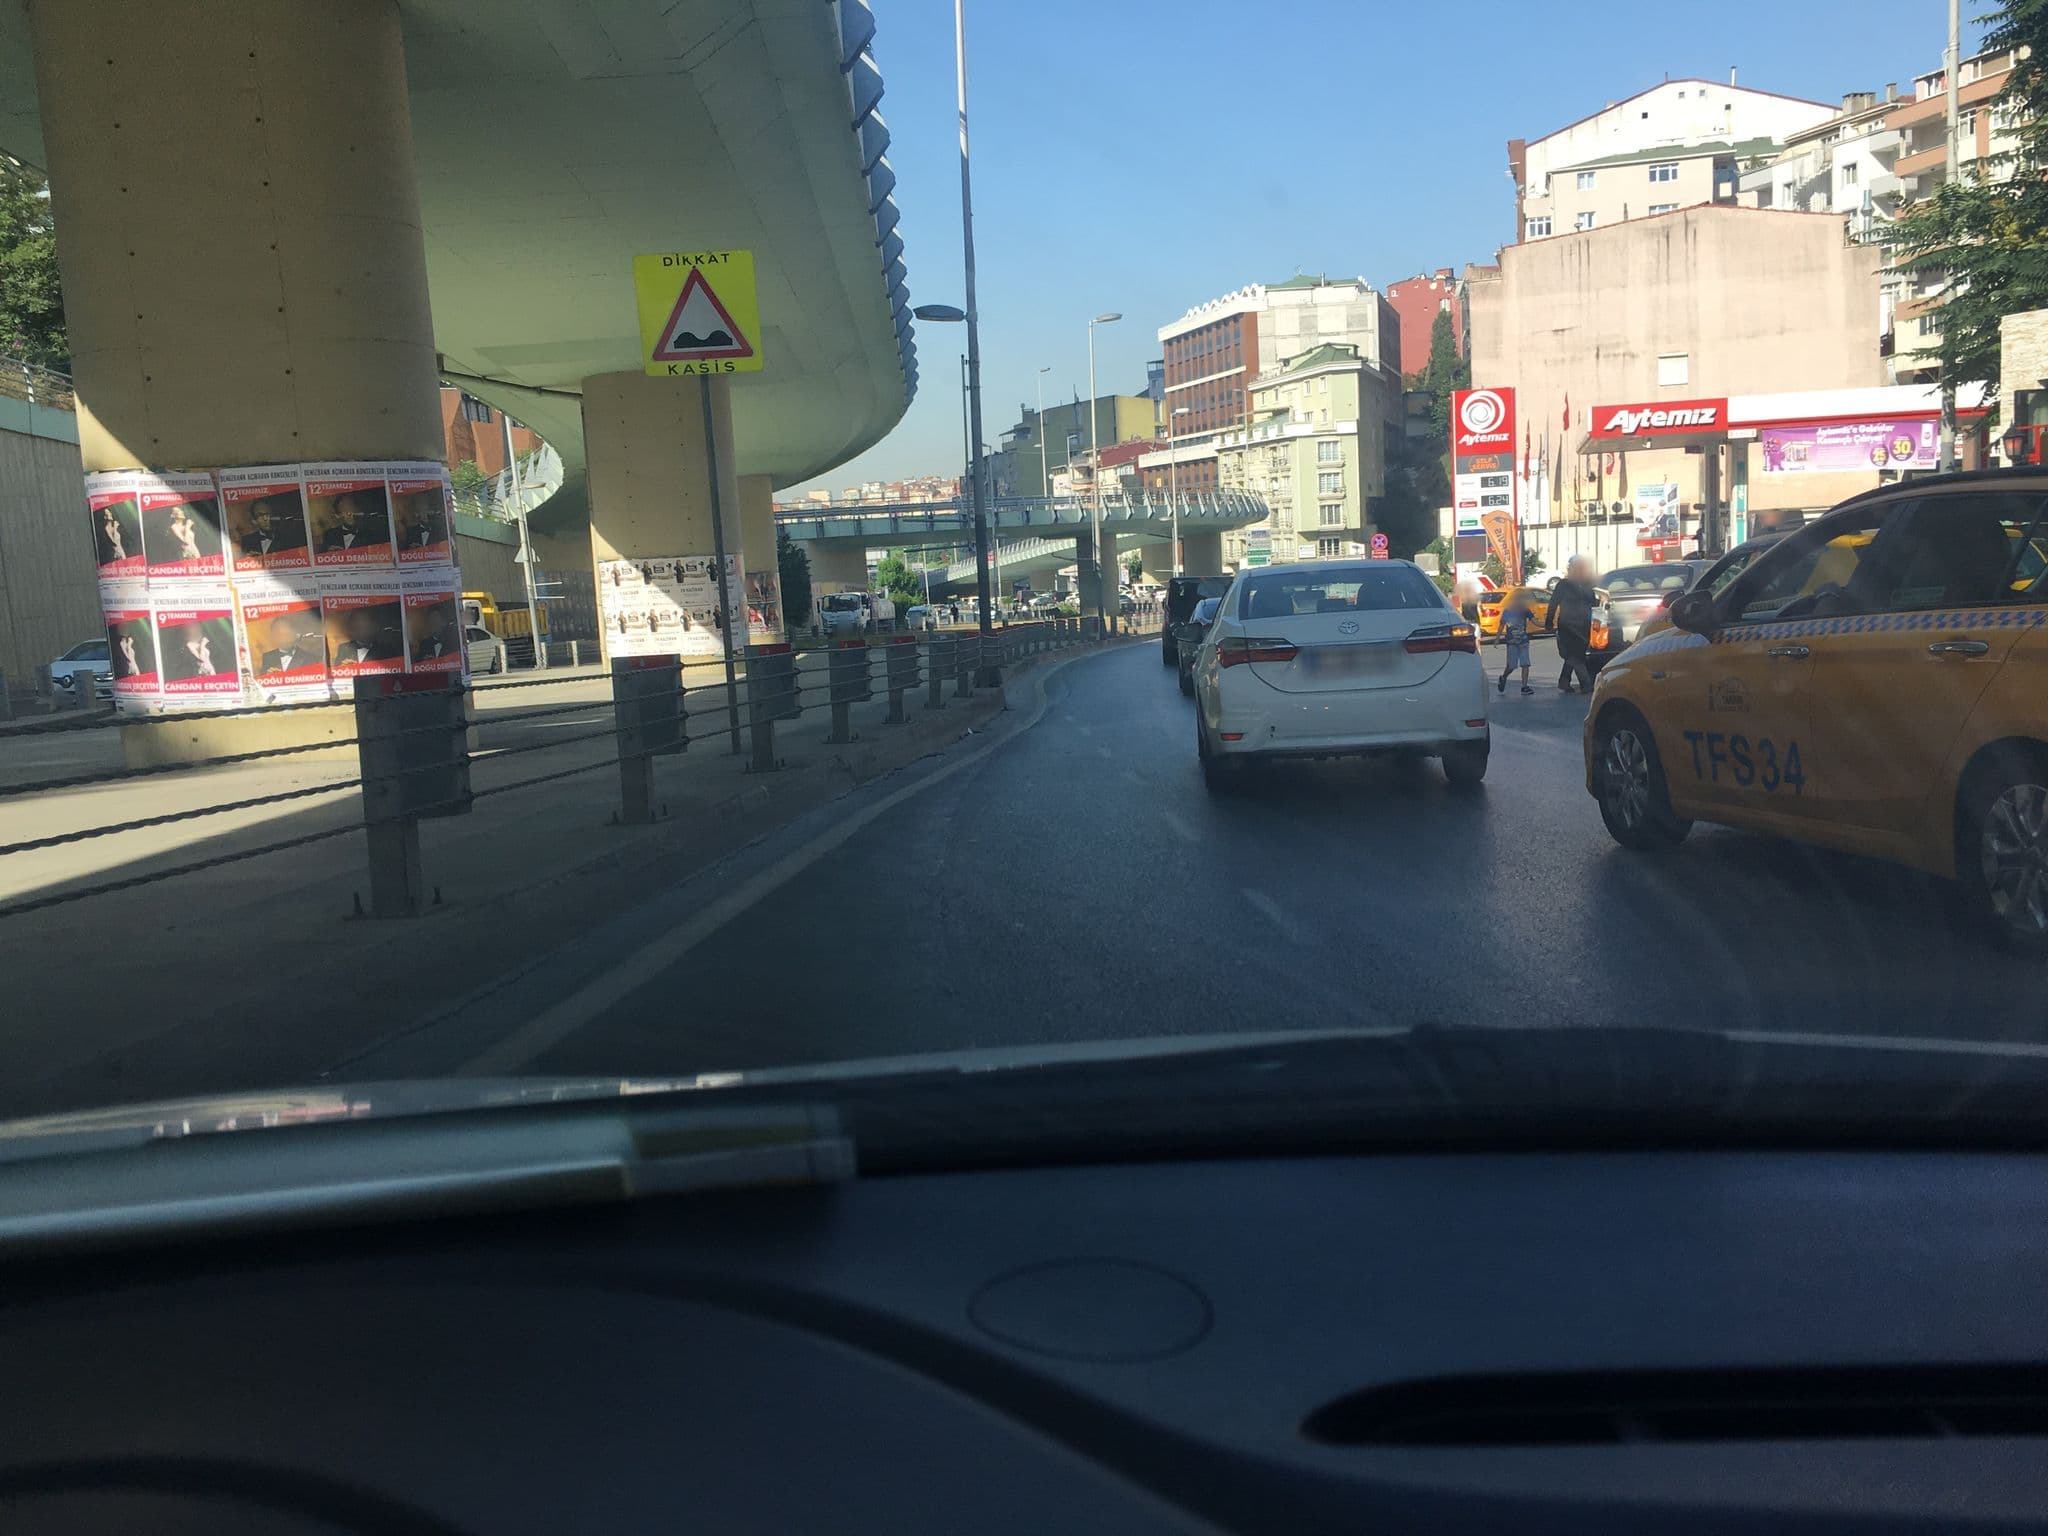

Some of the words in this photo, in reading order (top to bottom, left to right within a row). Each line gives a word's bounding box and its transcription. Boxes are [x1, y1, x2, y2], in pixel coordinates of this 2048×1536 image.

[663, 253, 730, 267] DİKKAT
[668, 360, 736, 375] KASİS
[1603, 408, 1717, 434] Aytemiz
[1458, 433, 1510, 446] Aytemiz
[225, 490, 238, 501] 12
[238, 487, 269, 496] TEMMUZ
[309, 484, 322, 494] 12
[322, 482, 353, 490] TEMMUZ
[392, 484, 403, 493] 12
[143, 495, 151, 506] 9
[1488, 496, 1509, 506] 6.24
[317, 553, 345, 563] DOĞU
[346, 552, 390, 562] DEMİRKOL
[402, 551, 423, 560] DOĞU
[236, 558, 262, 569] DOĞU
[264, 557, 307, 568] DEMİRKOL
[149, 566, 186, 575] CANDAN
[189, 565, 224, 575] ERÇETİN
[325, 598, 338, 609] 12
[407, 596, 418, 606] 12
[245, 608, 259, 619] 12
[259, 604, 289, 613] TEMMUZ
[158, 614, 167, 624] 9
[167, 612, 197, 620] TEMMUZ
[165, 682, 202, 691] CANDAN
[204, 681, 239, 691] ERÇETİN
[1683, 731, 1806, 795] TFS34
